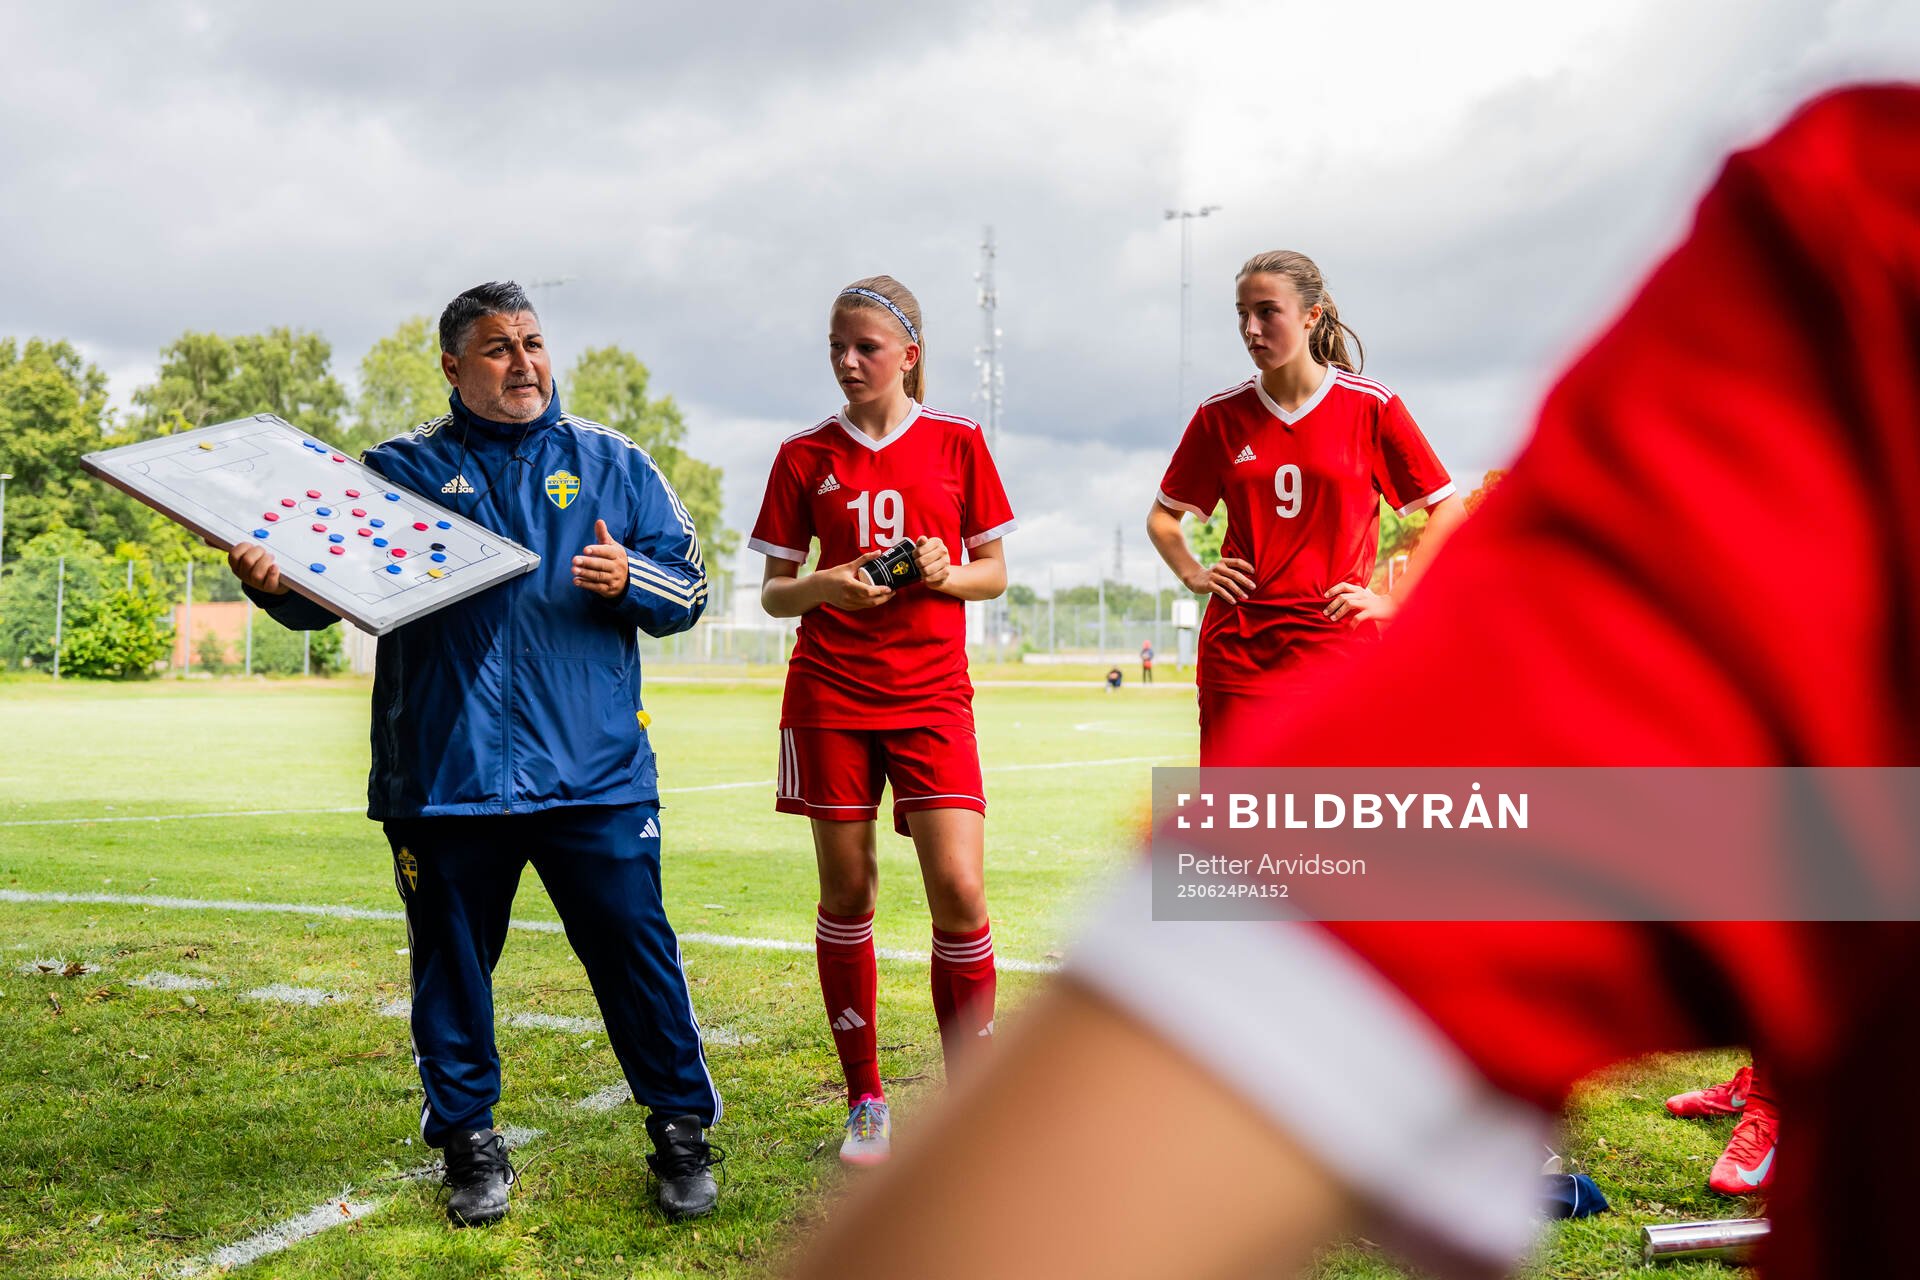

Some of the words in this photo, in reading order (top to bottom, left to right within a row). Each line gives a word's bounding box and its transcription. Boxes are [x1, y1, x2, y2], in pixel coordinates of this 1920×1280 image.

[1234, 454, 1257, 464] adidas
[817, 483, 840, 495] adidas
[1274, 464, 1302, 518] 9
[846, 489, 905, 548] 19
